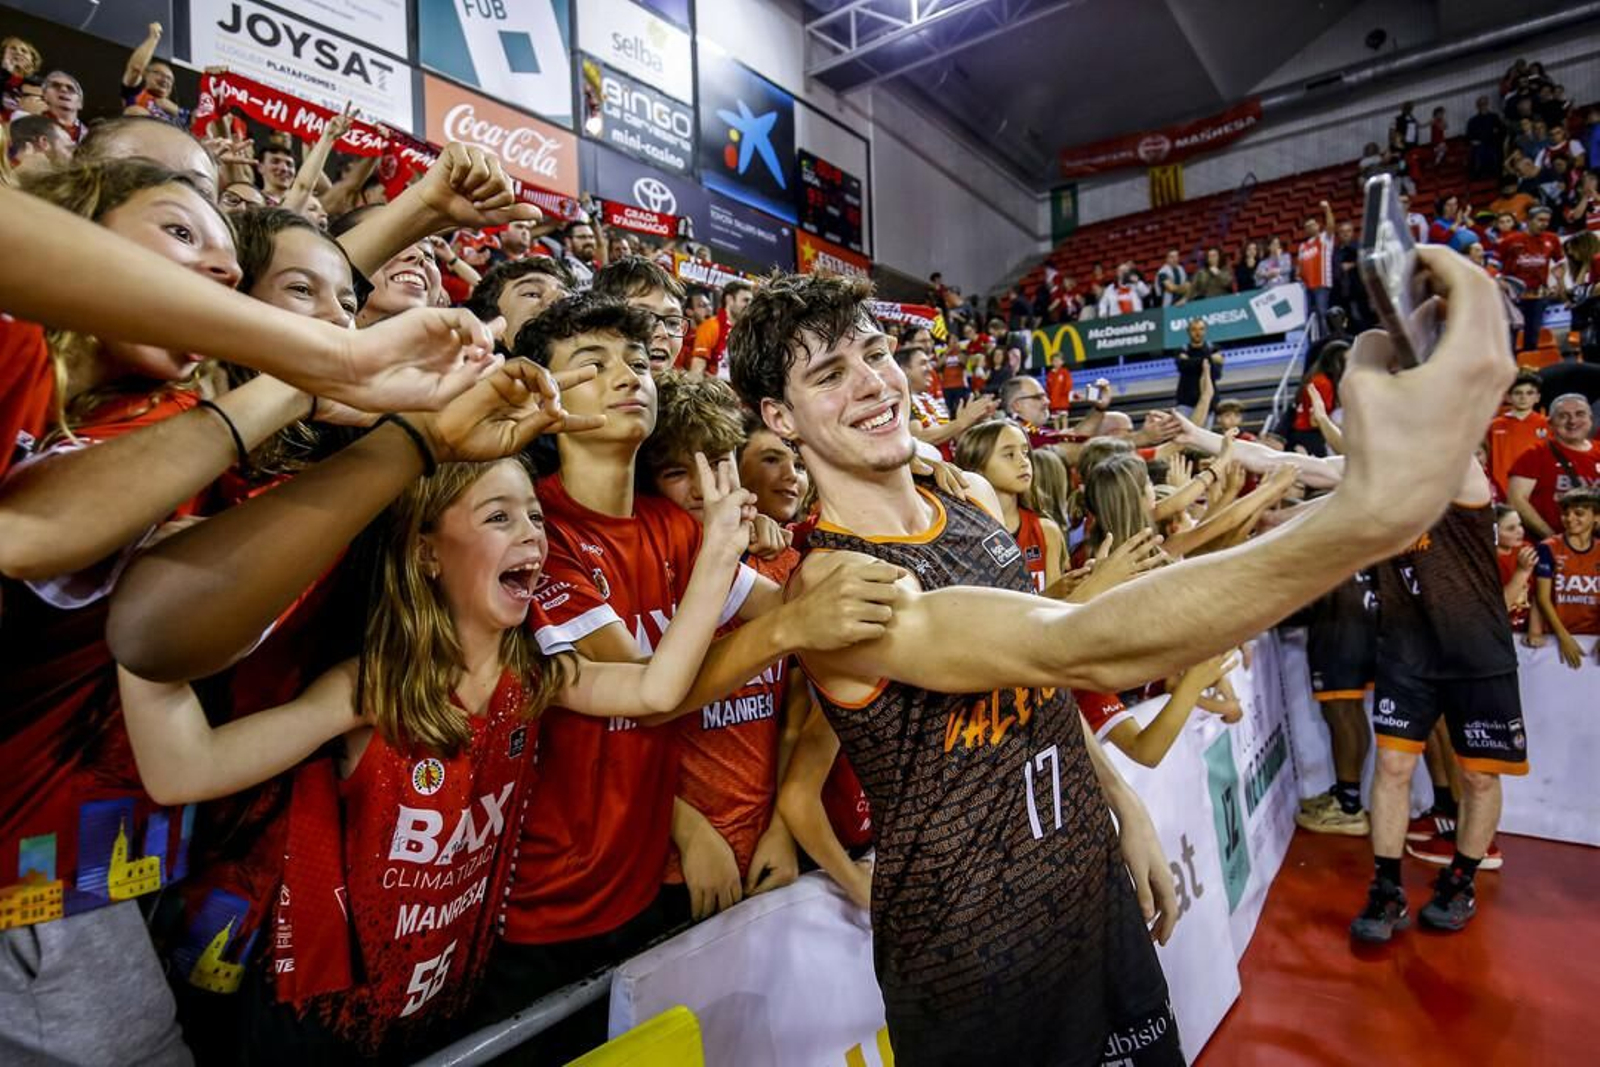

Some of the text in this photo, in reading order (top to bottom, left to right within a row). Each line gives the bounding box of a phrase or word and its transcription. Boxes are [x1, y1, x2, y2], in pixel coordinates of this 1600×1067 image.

[217, 3, 394, 91] JOYSAT
[611, 31, 664, 73] selba
[266, 60, 337, 91] PLATAFORMES
[611, 129, 685, 170] mini-casino
[624, 208, 659, 223] GRADA
[1088, 320, 1157, 340] McDonald's
[1096, 334, 1148, 350] Manresa
[1463, 729, 1491, 739] ETL
[1025, 744, 1063, 840] 17
[394, 876, 488, 941] MANRESA
[400, 938, 459, 1018] 55
